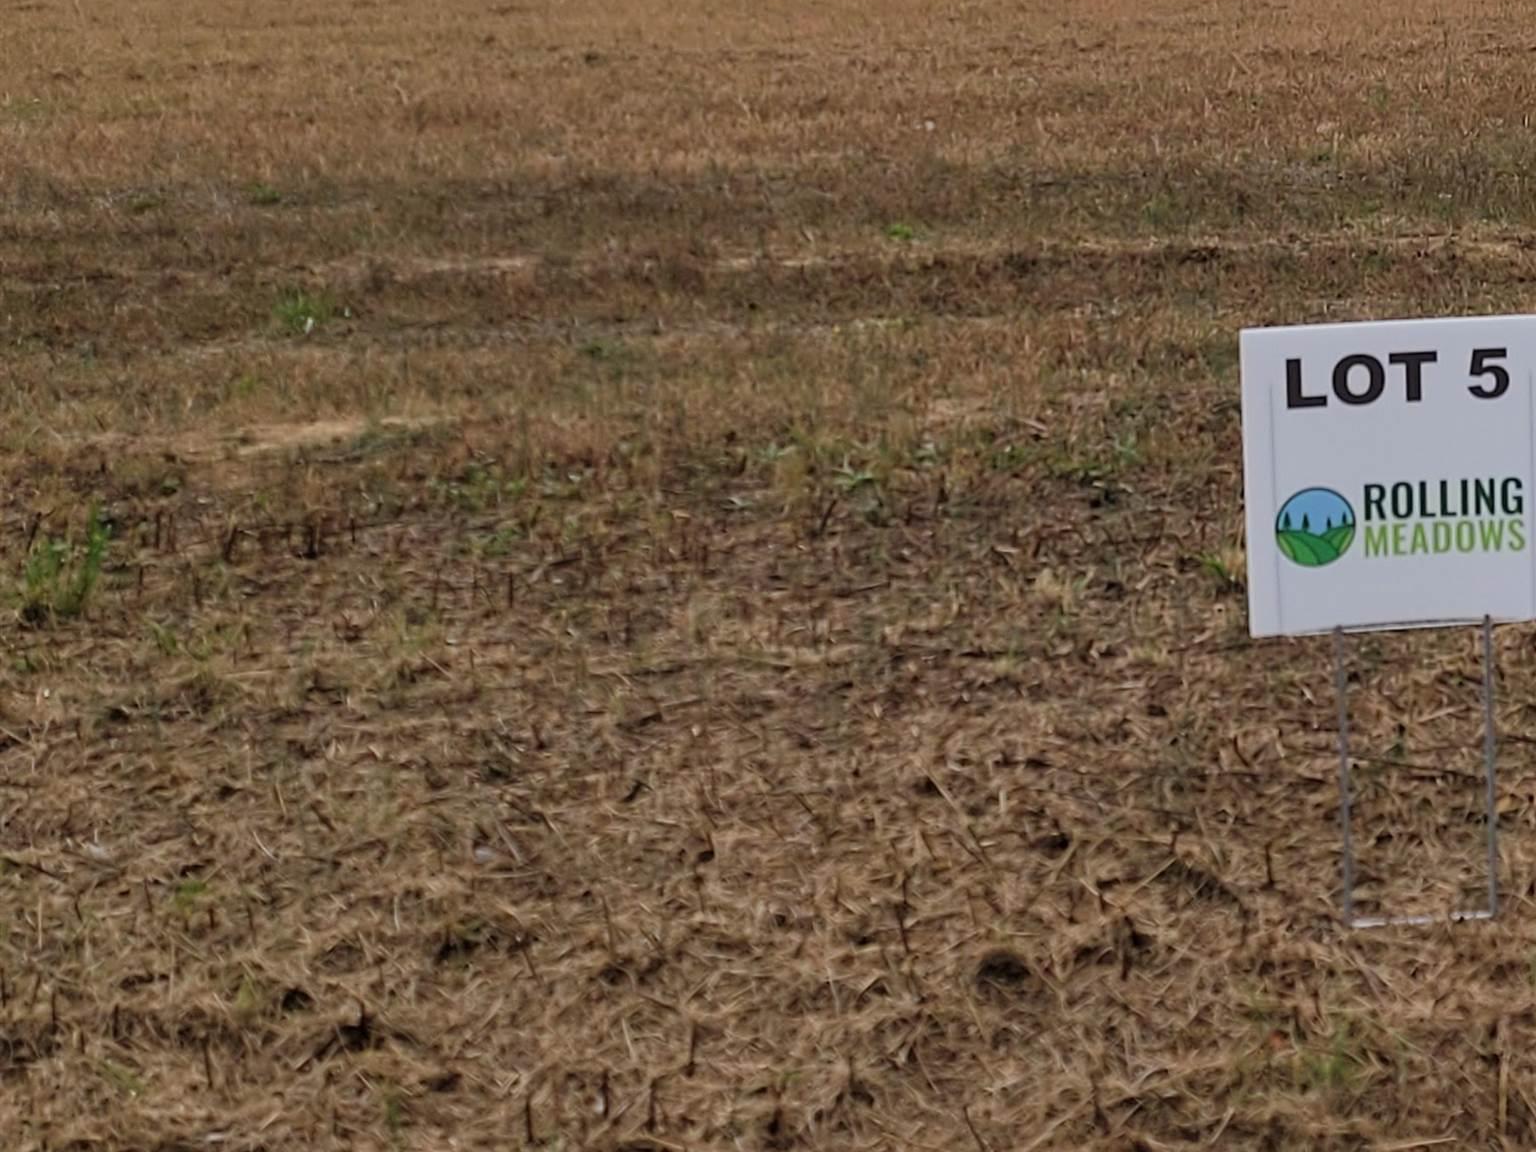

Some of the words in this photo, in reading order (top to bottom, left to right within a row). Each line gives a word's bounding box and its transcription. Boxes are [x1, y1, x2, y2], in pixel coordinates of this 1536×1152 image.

[1286, 351, 1437, 408] LOT
[1467, 348, 1510, 399] 5
[1363, 477, 1523, 521] ROLLING
[1363, 520, 1526, 558] MEADOWS
